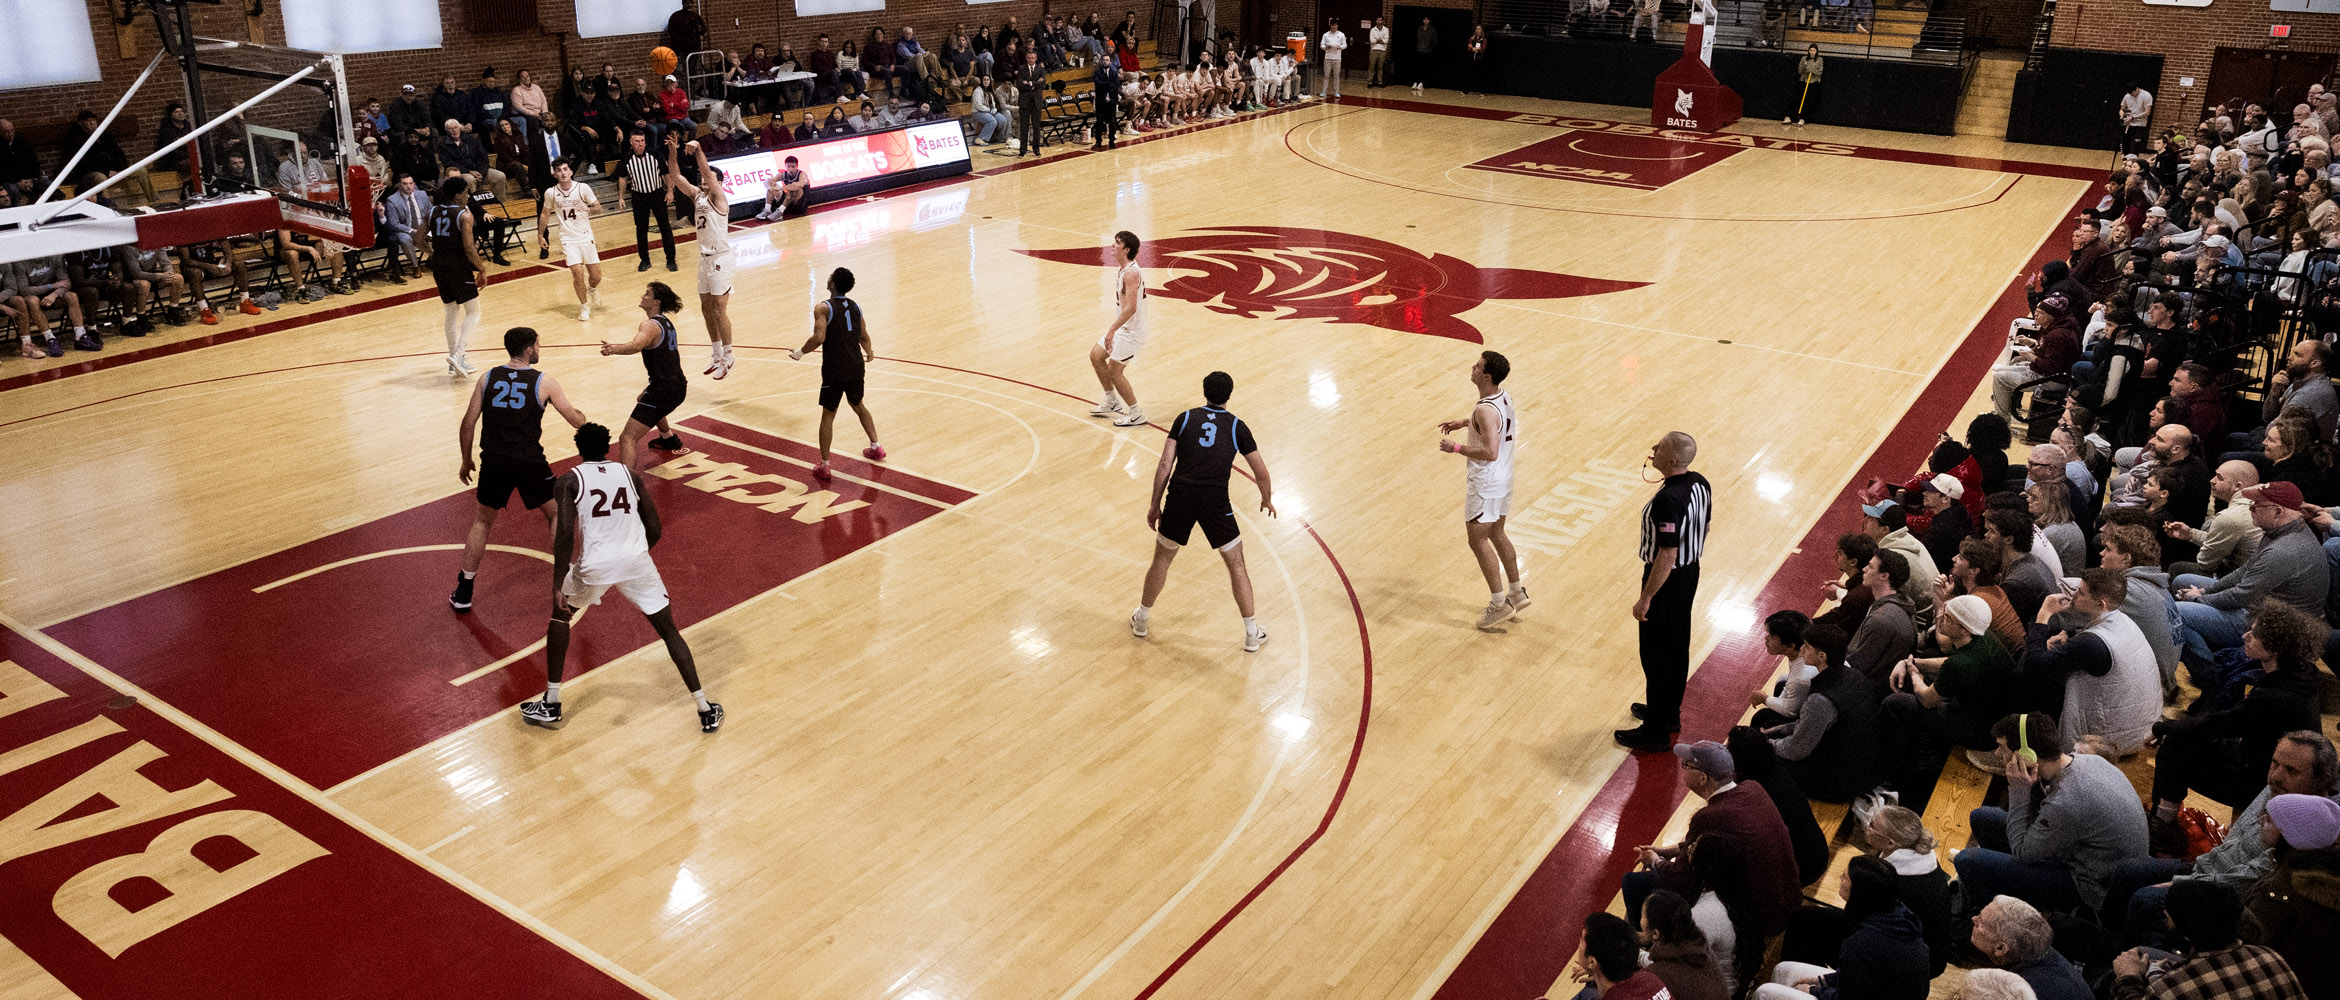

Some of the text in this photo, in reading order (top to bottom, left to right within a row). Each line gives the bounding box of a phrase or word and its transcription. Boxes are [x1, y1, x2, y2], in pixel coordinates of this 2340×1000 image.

[2273, 26, 2288, 36] EXIT
[1667, 117, 1698, 128] BATES
[928, 136, 960, 151] BATES
[1504, 113, 1857, 156] BOBCATS
[808, 150, 888, 182] BOBCATS
[734, 168, 774, 186] BATES
[473, 191, 495, 202] BATES
[562, 208, 577, 221] 14
[435, 216, 450, 236] 12
[845, 309, 853, 331] 1
[492, 380, 528, 410] 25
[1198, 421, 1218, 448] 3
[644, 451, 873, 525] NCAA
[589, 486, 632, 518] 24
